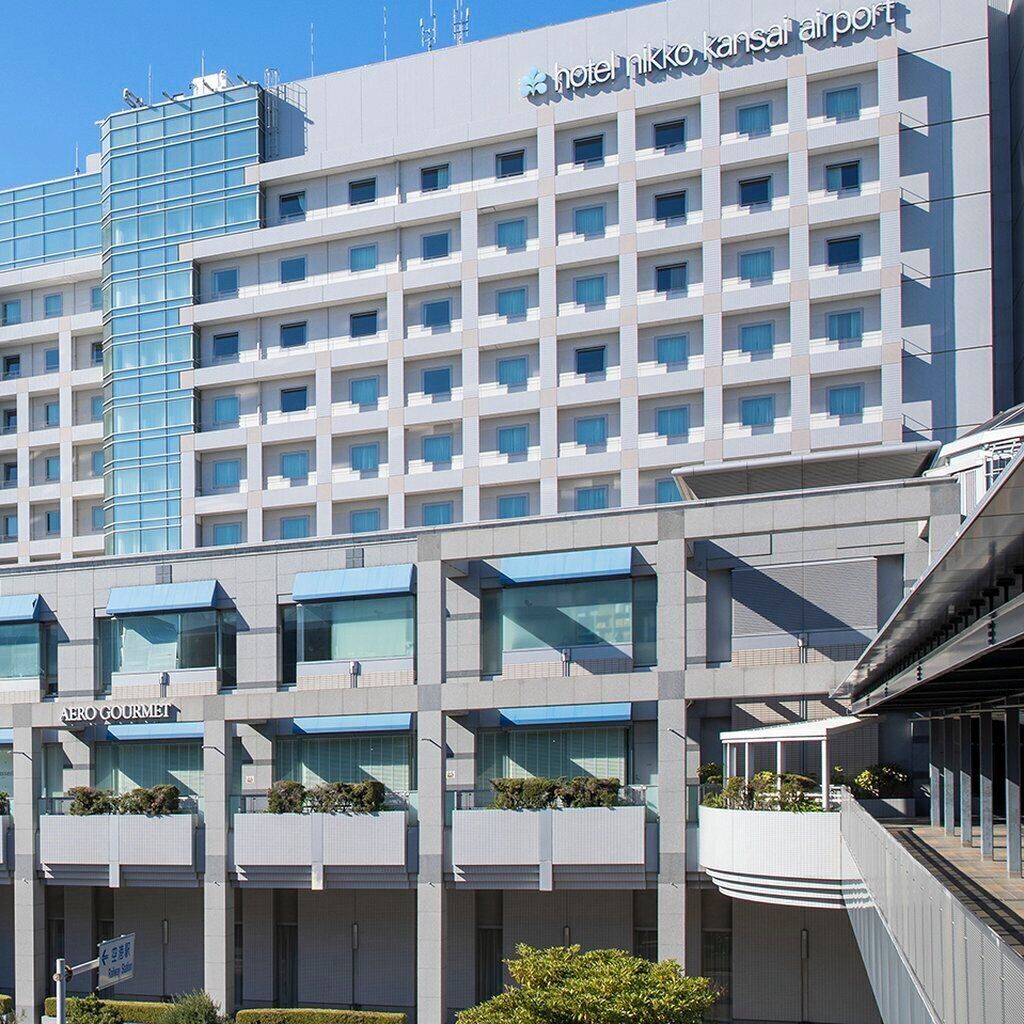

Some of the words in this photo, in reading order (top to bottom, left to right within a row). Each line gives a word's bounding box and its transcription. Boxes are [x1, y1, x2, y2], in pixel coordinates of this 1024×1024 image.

[553, 50, 616, 92] hotel
[625, 41, 694, 78] nikko
[702, 14, 790, 62] kansai
[60, 706, 97, 722] AERO
[99, 703, 172, 720] GOURMET
